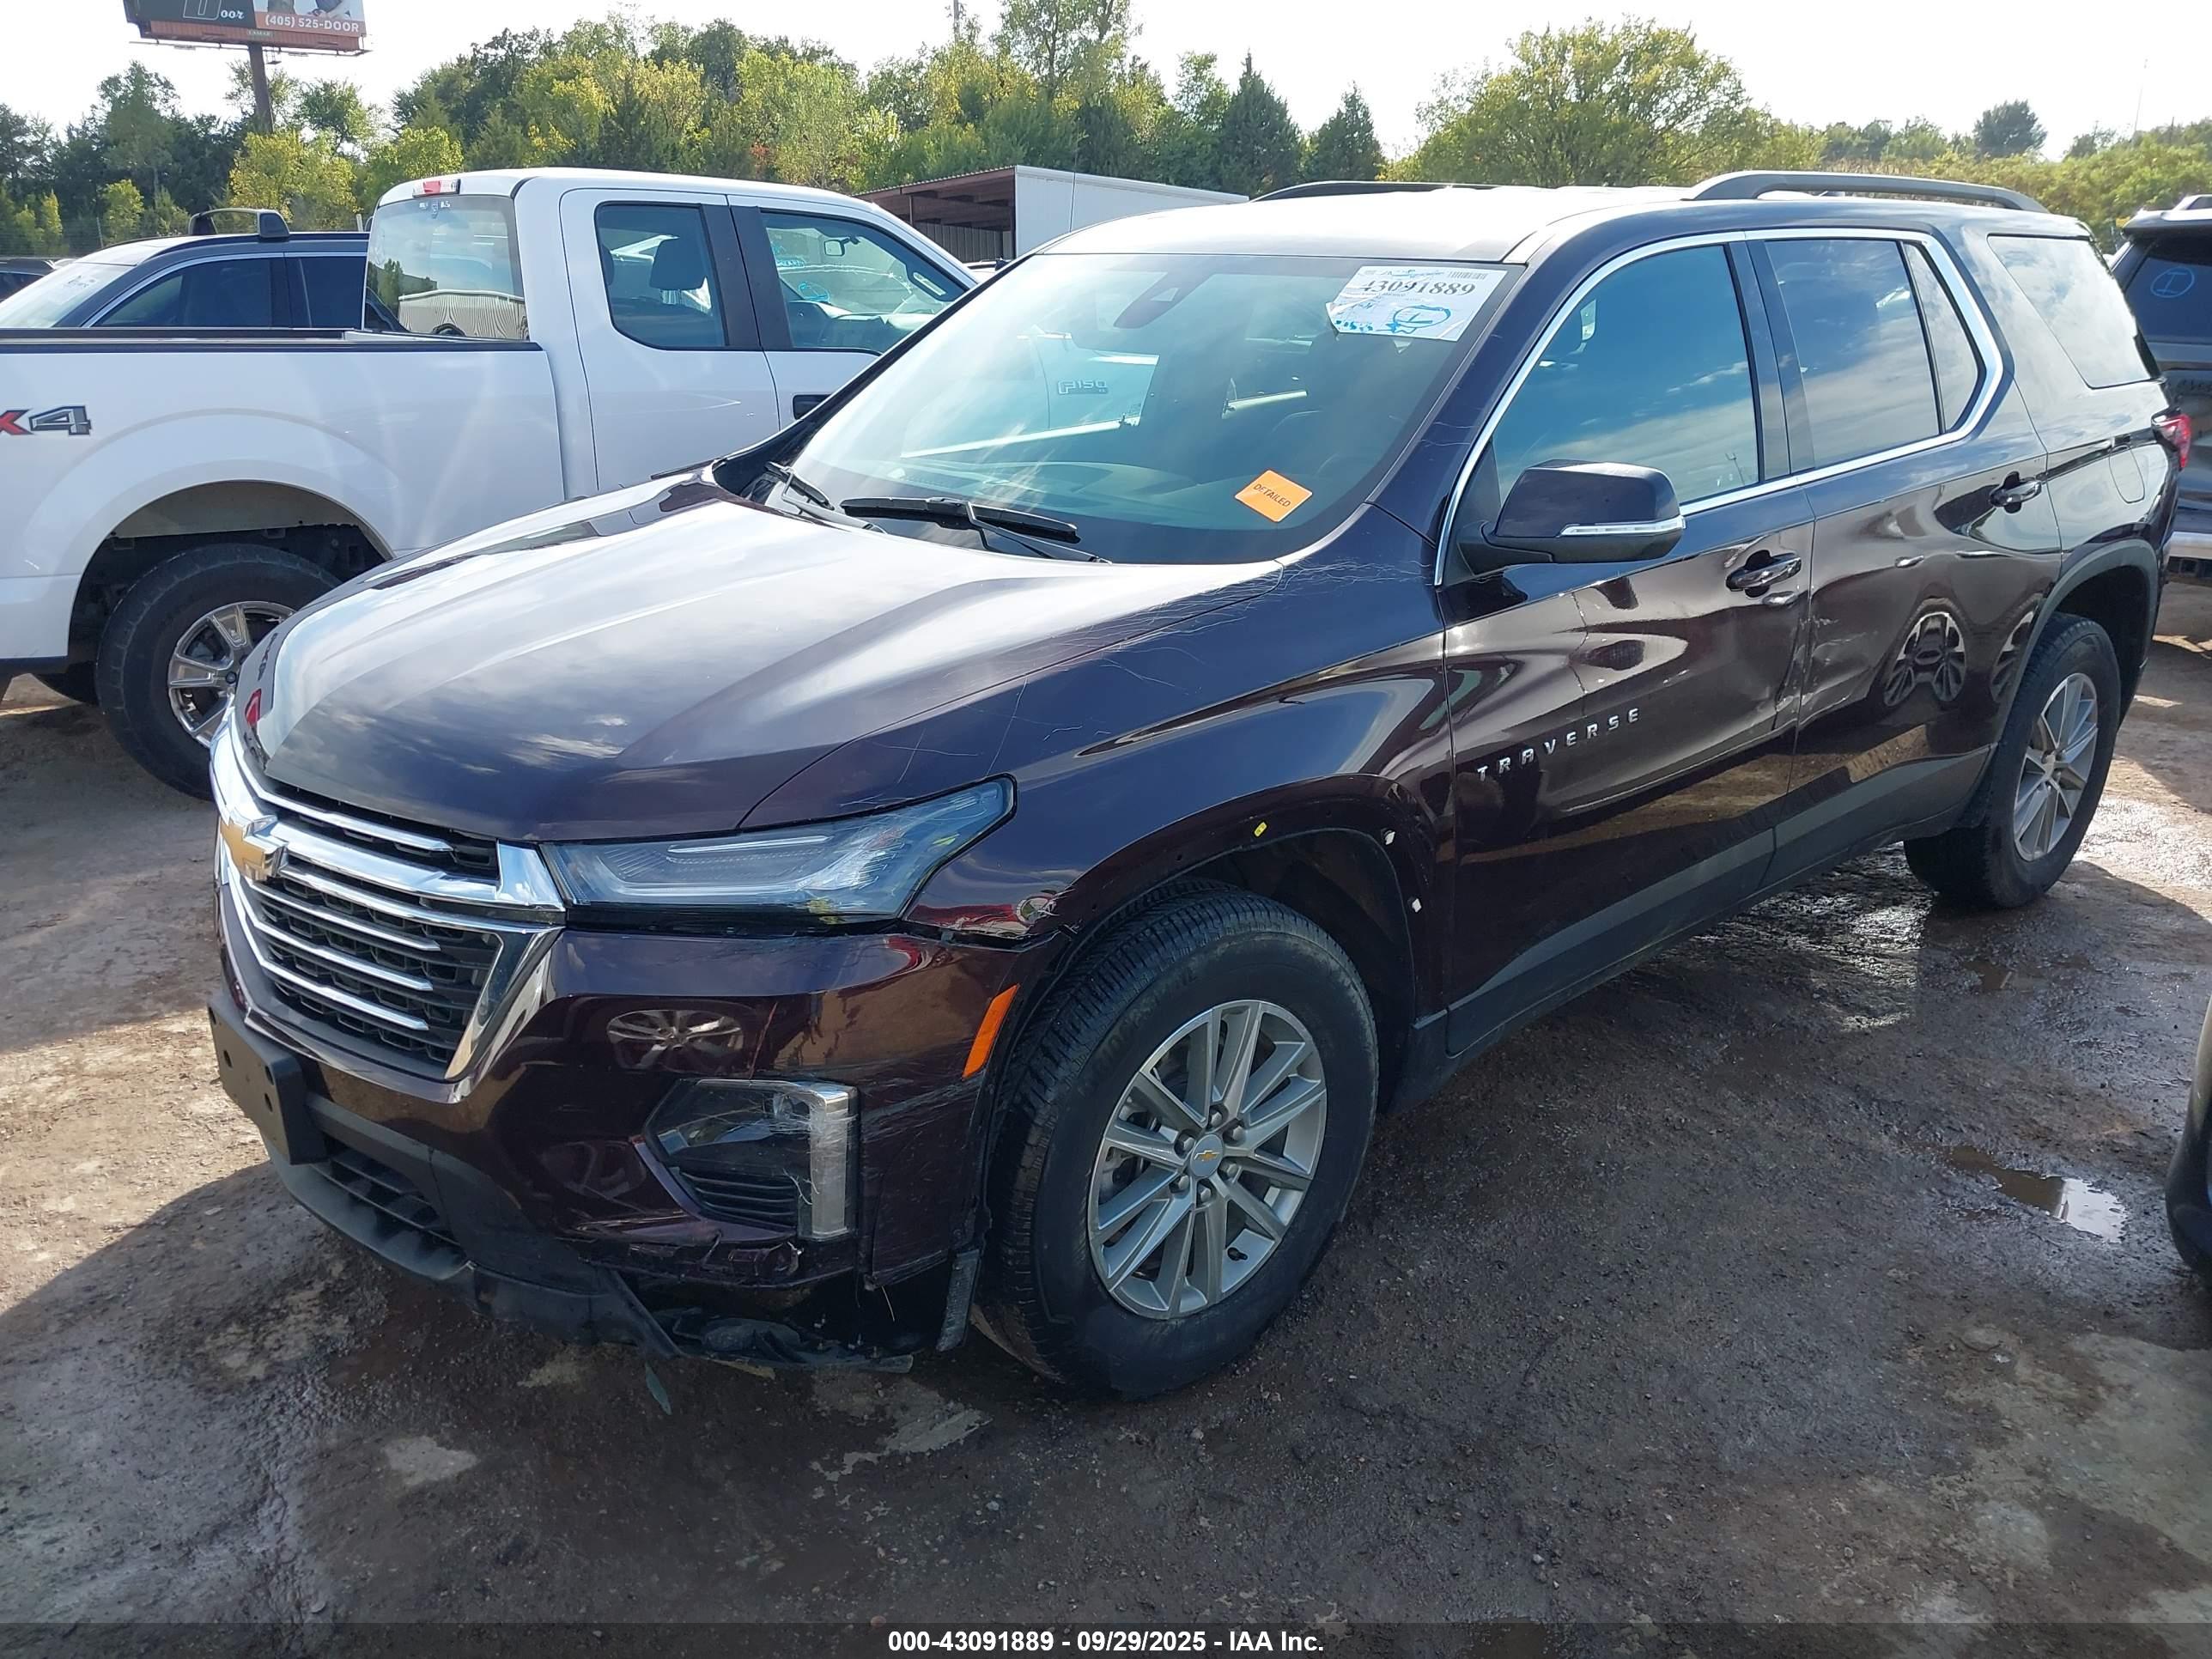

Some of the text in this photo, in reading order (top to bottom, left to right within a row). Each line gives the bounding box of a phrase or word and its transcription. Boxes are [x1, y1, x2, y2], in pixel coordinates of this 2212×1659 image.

[265, 15, 359, 33] (405) 525-DOOR
[1361, 280, 1476, 295] 43091889
[1254, 483, 1291, 507] DETAILED
[1477, 708, 1639, 781] TRAVERSE
